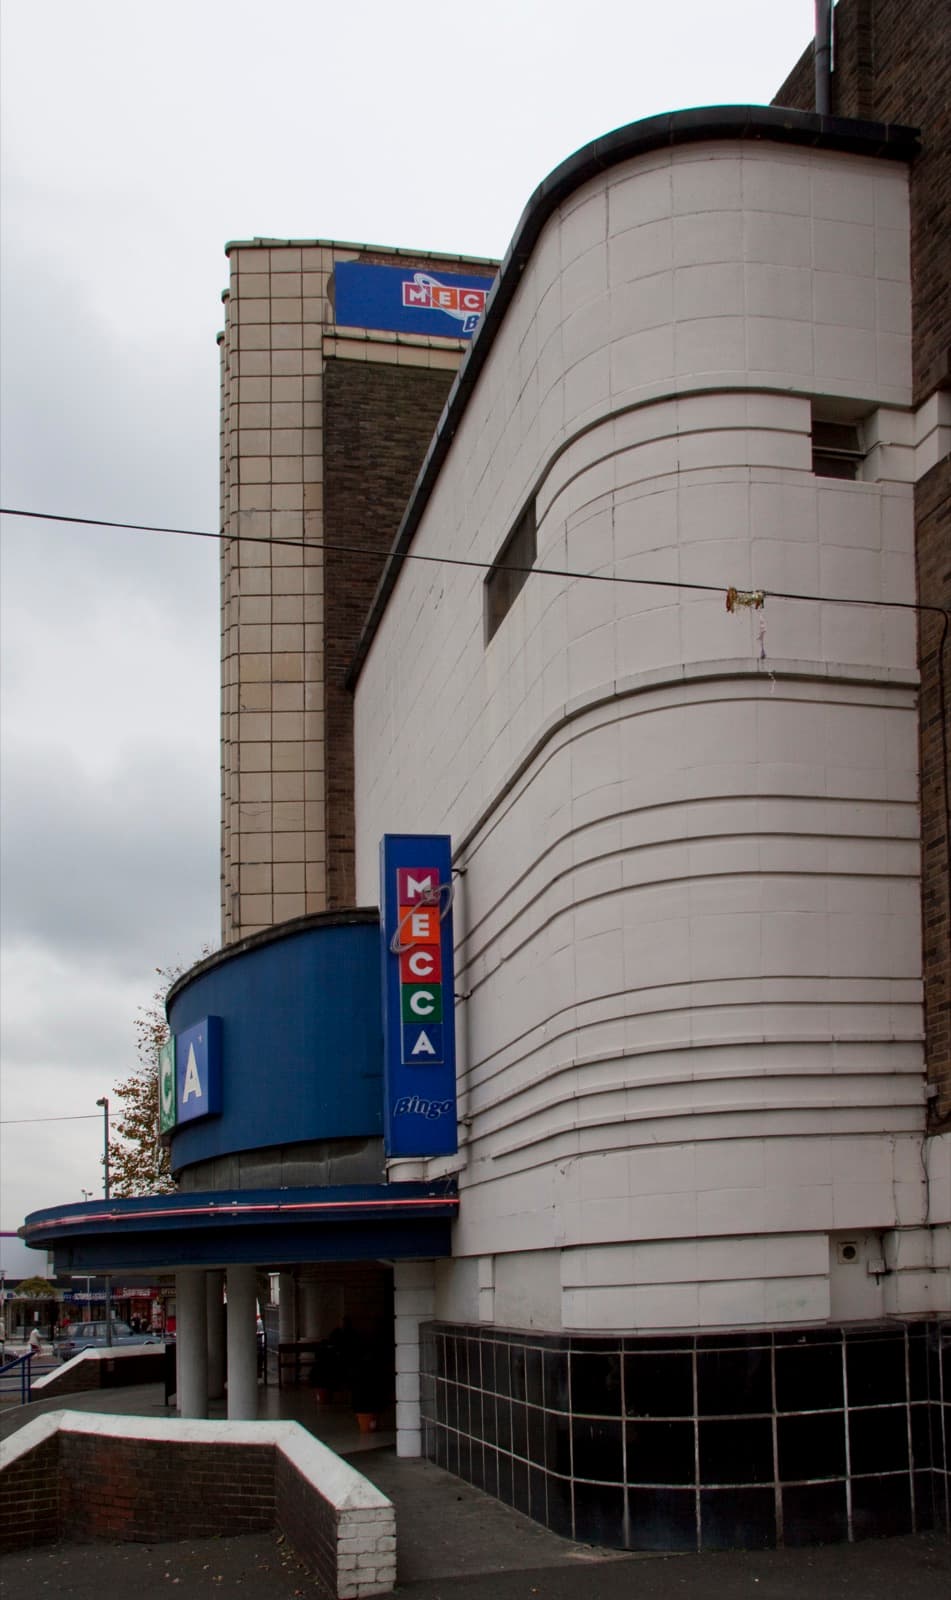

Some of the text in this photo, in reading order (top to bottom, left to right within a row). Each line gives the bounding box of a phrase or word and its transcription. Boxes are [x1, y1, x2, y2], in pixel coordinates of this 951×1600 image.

[408, 290, 481, 309] MEC
[406, 874, 436, 1055] MECCA
[393, 1096, 454, 1121] Bingo
